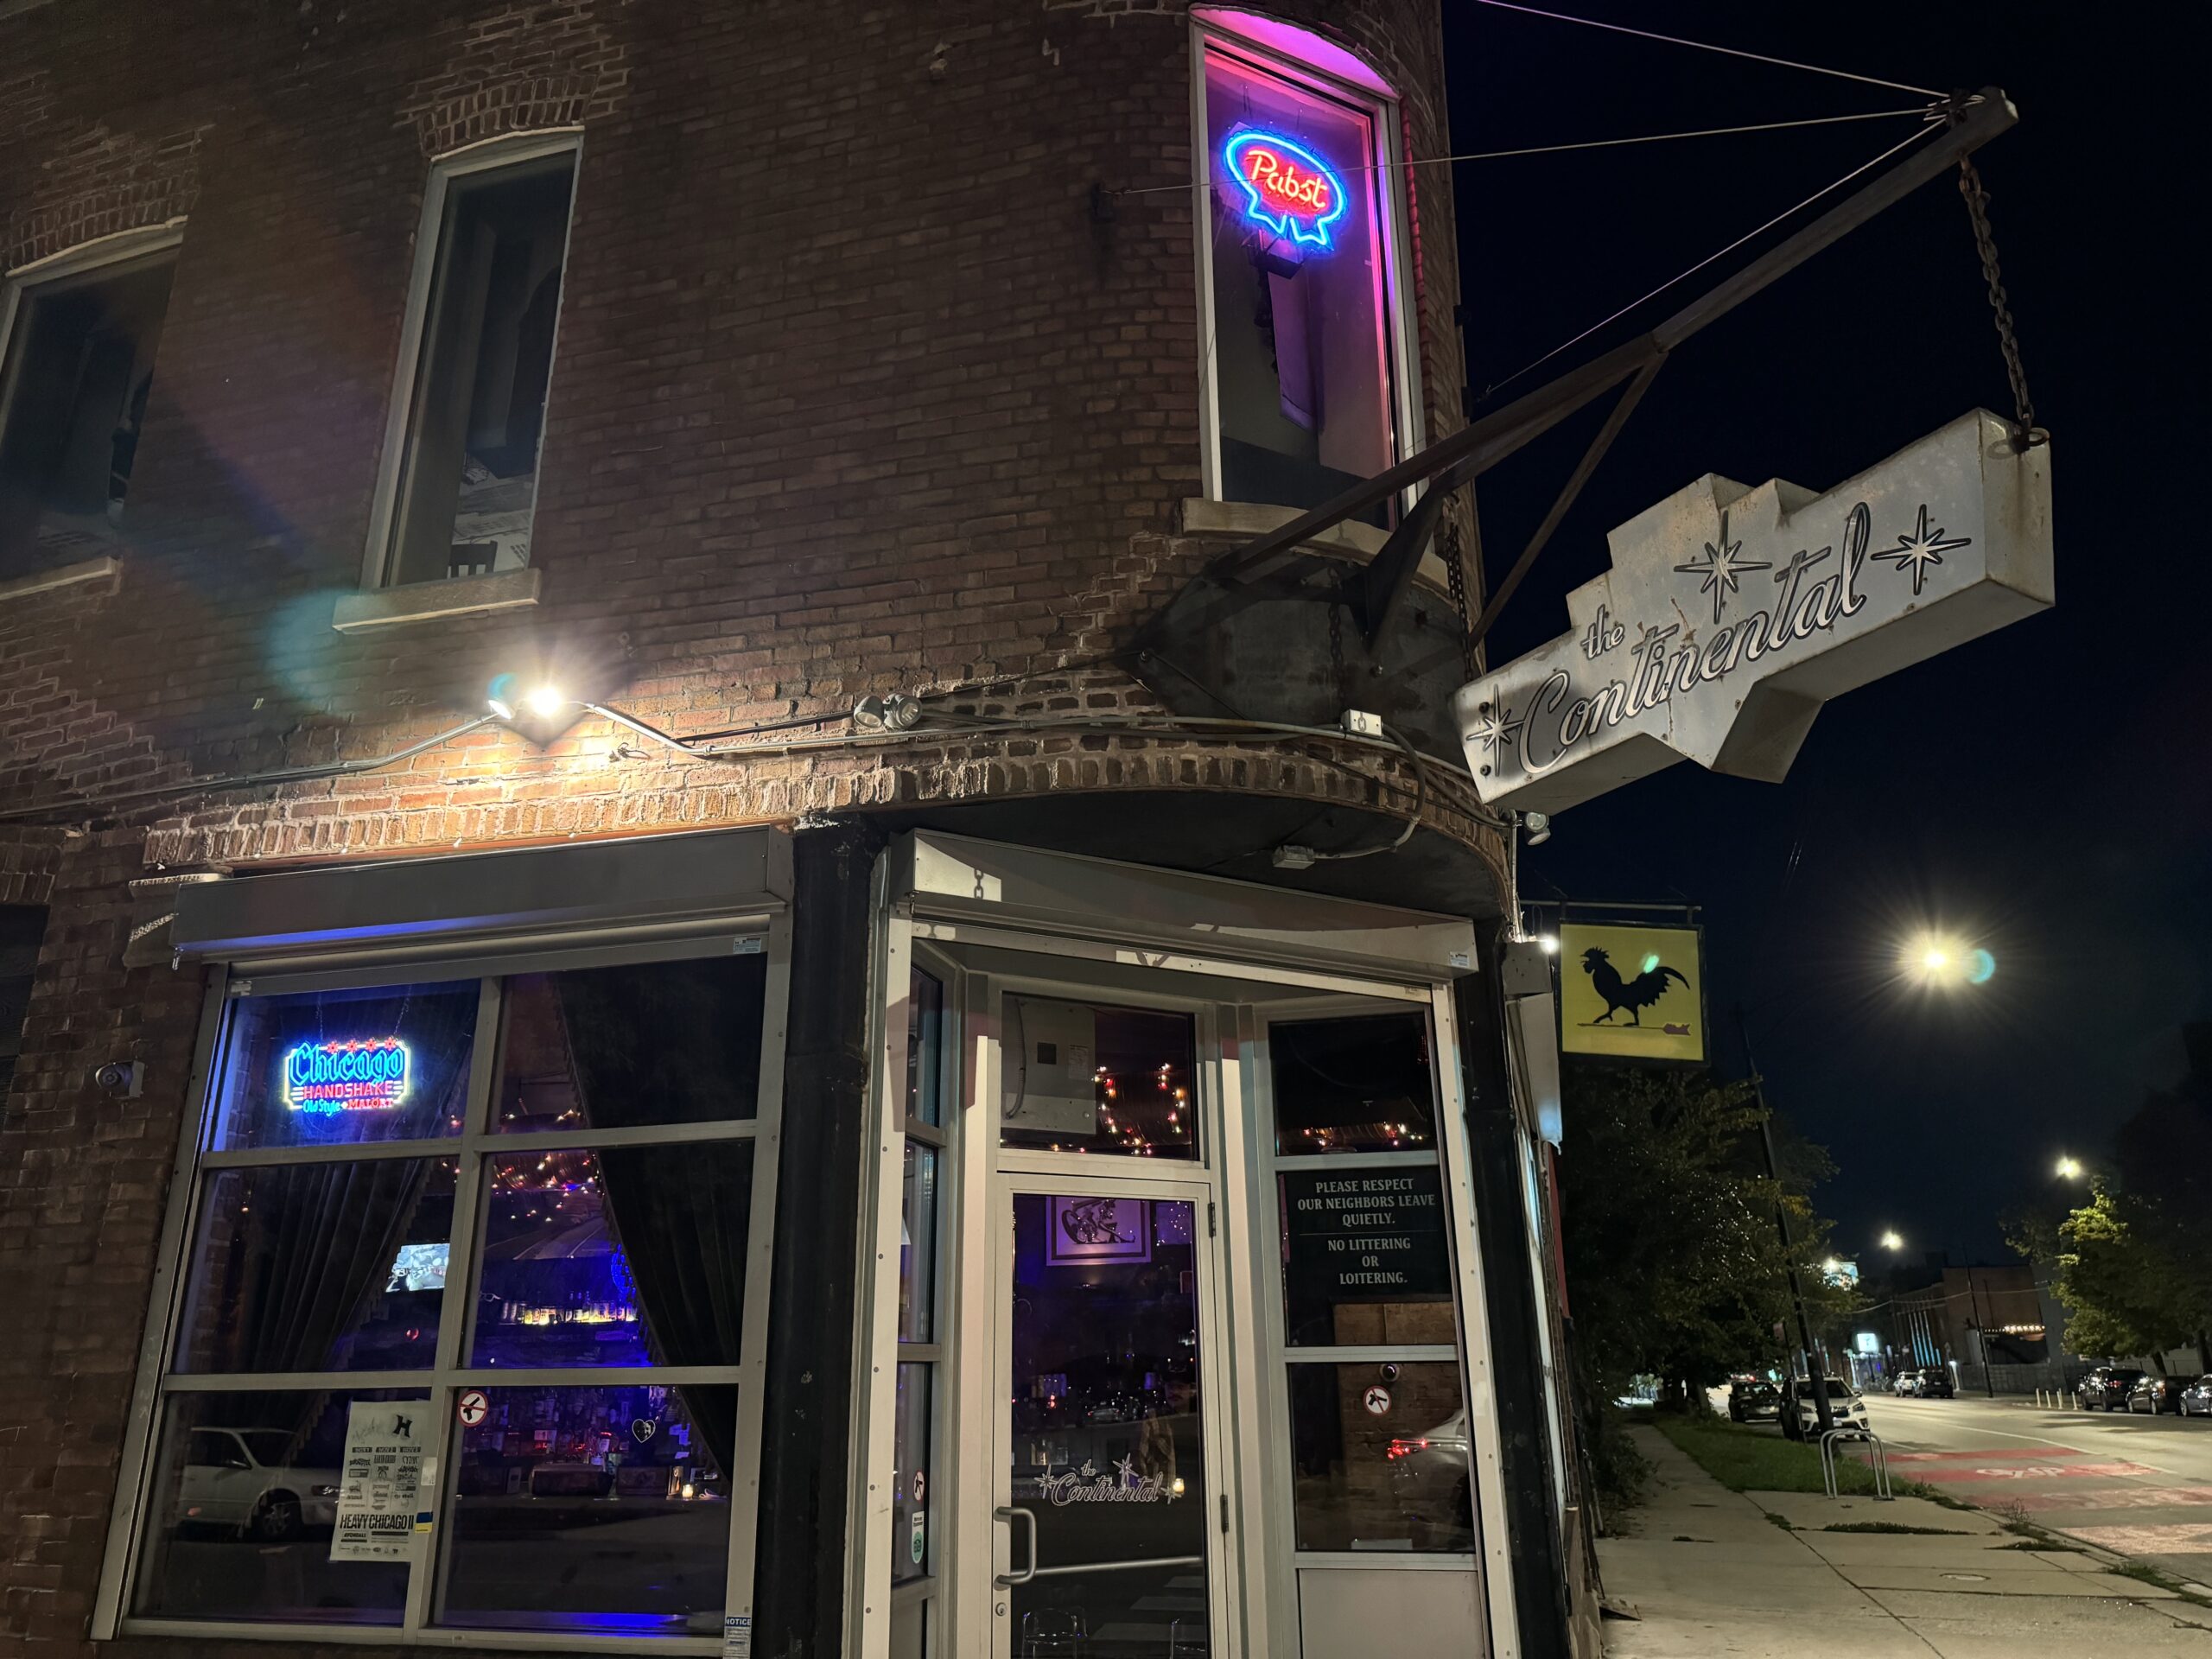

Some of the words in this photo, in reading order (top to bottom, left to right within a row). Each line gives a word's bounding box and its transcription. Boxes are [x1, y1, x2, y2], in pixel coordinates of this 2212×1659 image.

[1248, 149, 1328, 209] Pabst
[1518, 499, 1871, 776] Continental
[1581, 603, 1625, 661] the
[289, 1042, 404, 1086] Chicago
[303, 1082, 393, 1099] HANDSHAKE
[303, 1099, 319, 1114] Old
[319, 1098, 340, 1117] Style
[1316, 1180, 1359, 1193] PLEASE
[1363, 1179, 1414, 1191] RESPECT
[1298, 1199, 1323, 1210] OUR
[1325, 1196, 1395, 1209] NEIGHBORS
[1398, 1194, 1435, 1206] LEAVE
[1342, 1212, 1395, 1227] QUIETLY.
[1328, 1239, 1345, 1251] NO
[1349, 1237, 1411, 1250] LITTERING
[1362, 1255, 1379, 1268] OR
[1339, 1272, 1408, 1285] LOITERING.
[1081, 1459, 1096, 1477] the
[1051, 1471, 1163, 1506] Continental
[340, 1515, 369, 1529] HEAVY
